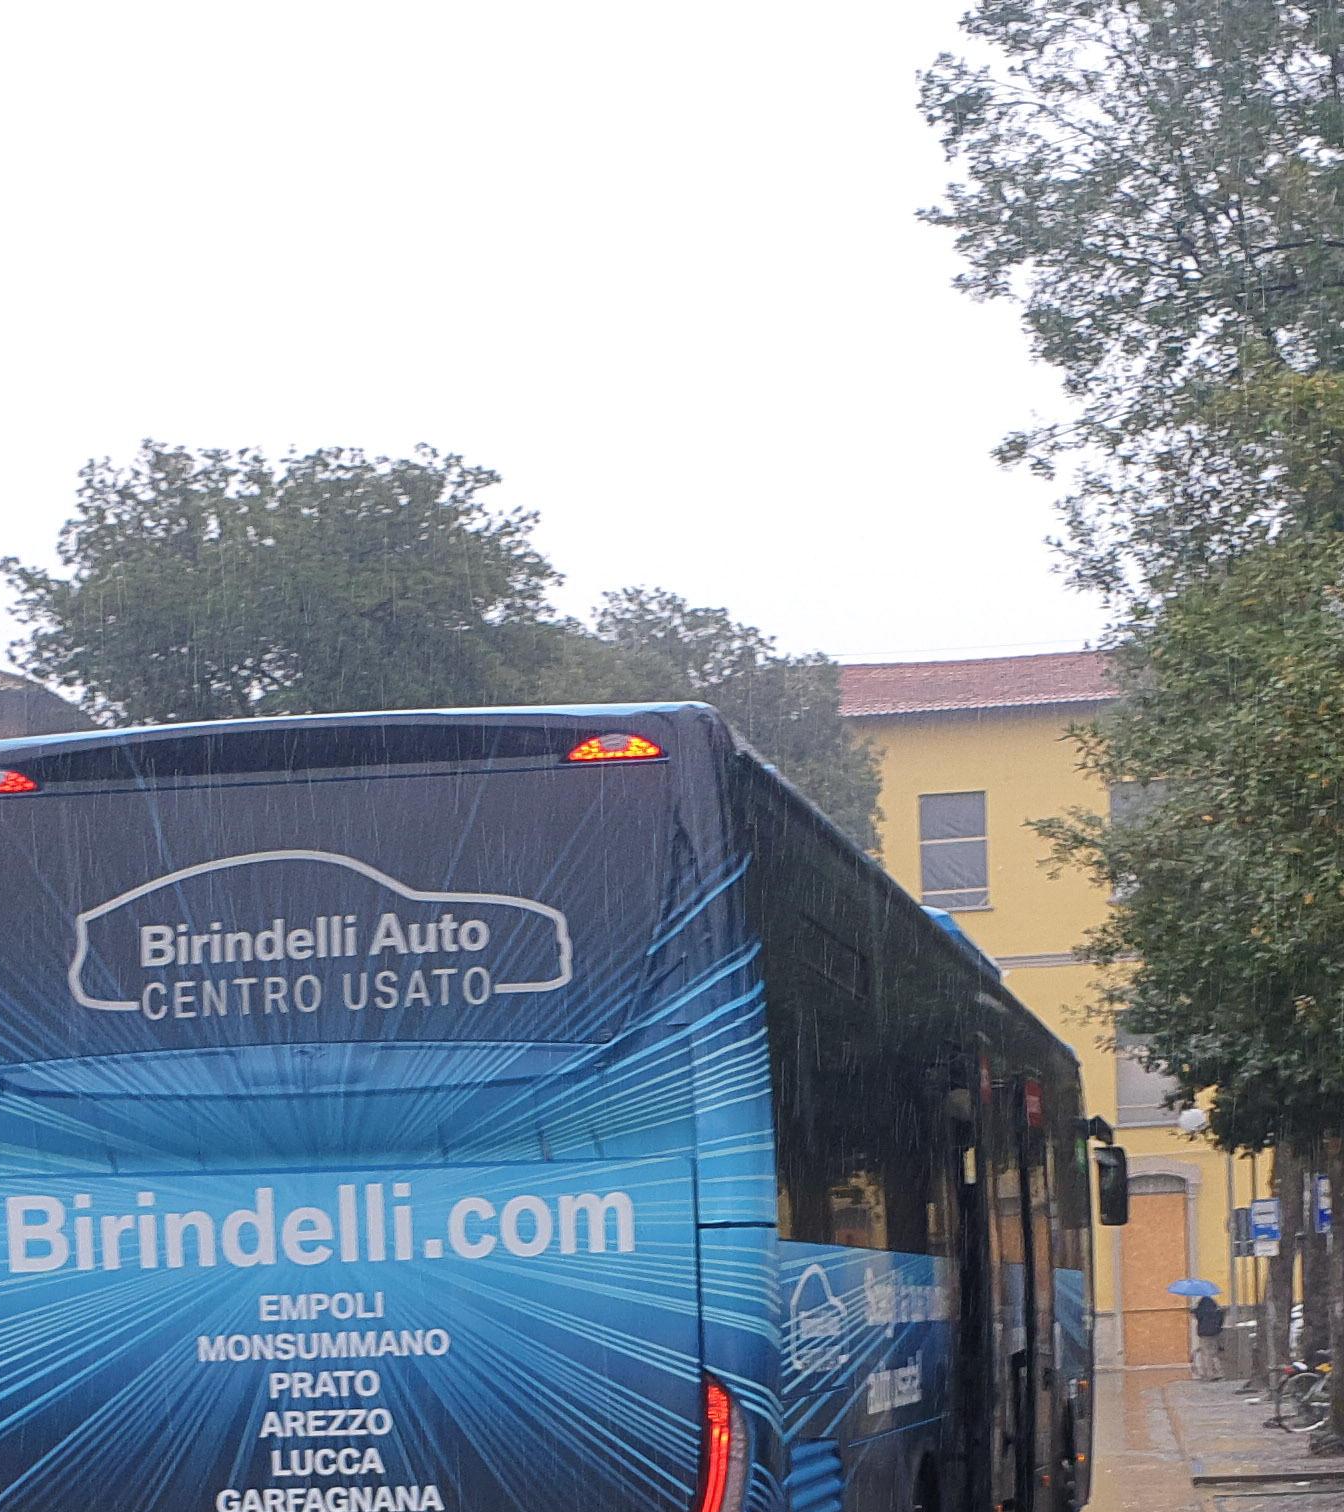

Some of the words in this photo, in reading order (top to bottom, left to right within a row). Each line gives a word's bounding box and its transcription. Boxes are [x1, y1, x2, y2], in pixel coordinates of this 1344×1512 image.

[140, 914, 357, 968] Birindelli
[368, 912, 490, 956] Auto
[142, 973, 322, 1021] CENTRO
[342, 966, 492, 1011] USATO
[6, 1182, 635, 1273] Birindelli.com
[258, 1291, 385, 1322] EMPOLI
[197, 1328, 451, 1363] MONSUMMANO
[269, 1369, 380, 1399] PRATO
[259, 1407, 394, 1438] AREZZO
[271, 1447, 385, 1477] LUCCA
